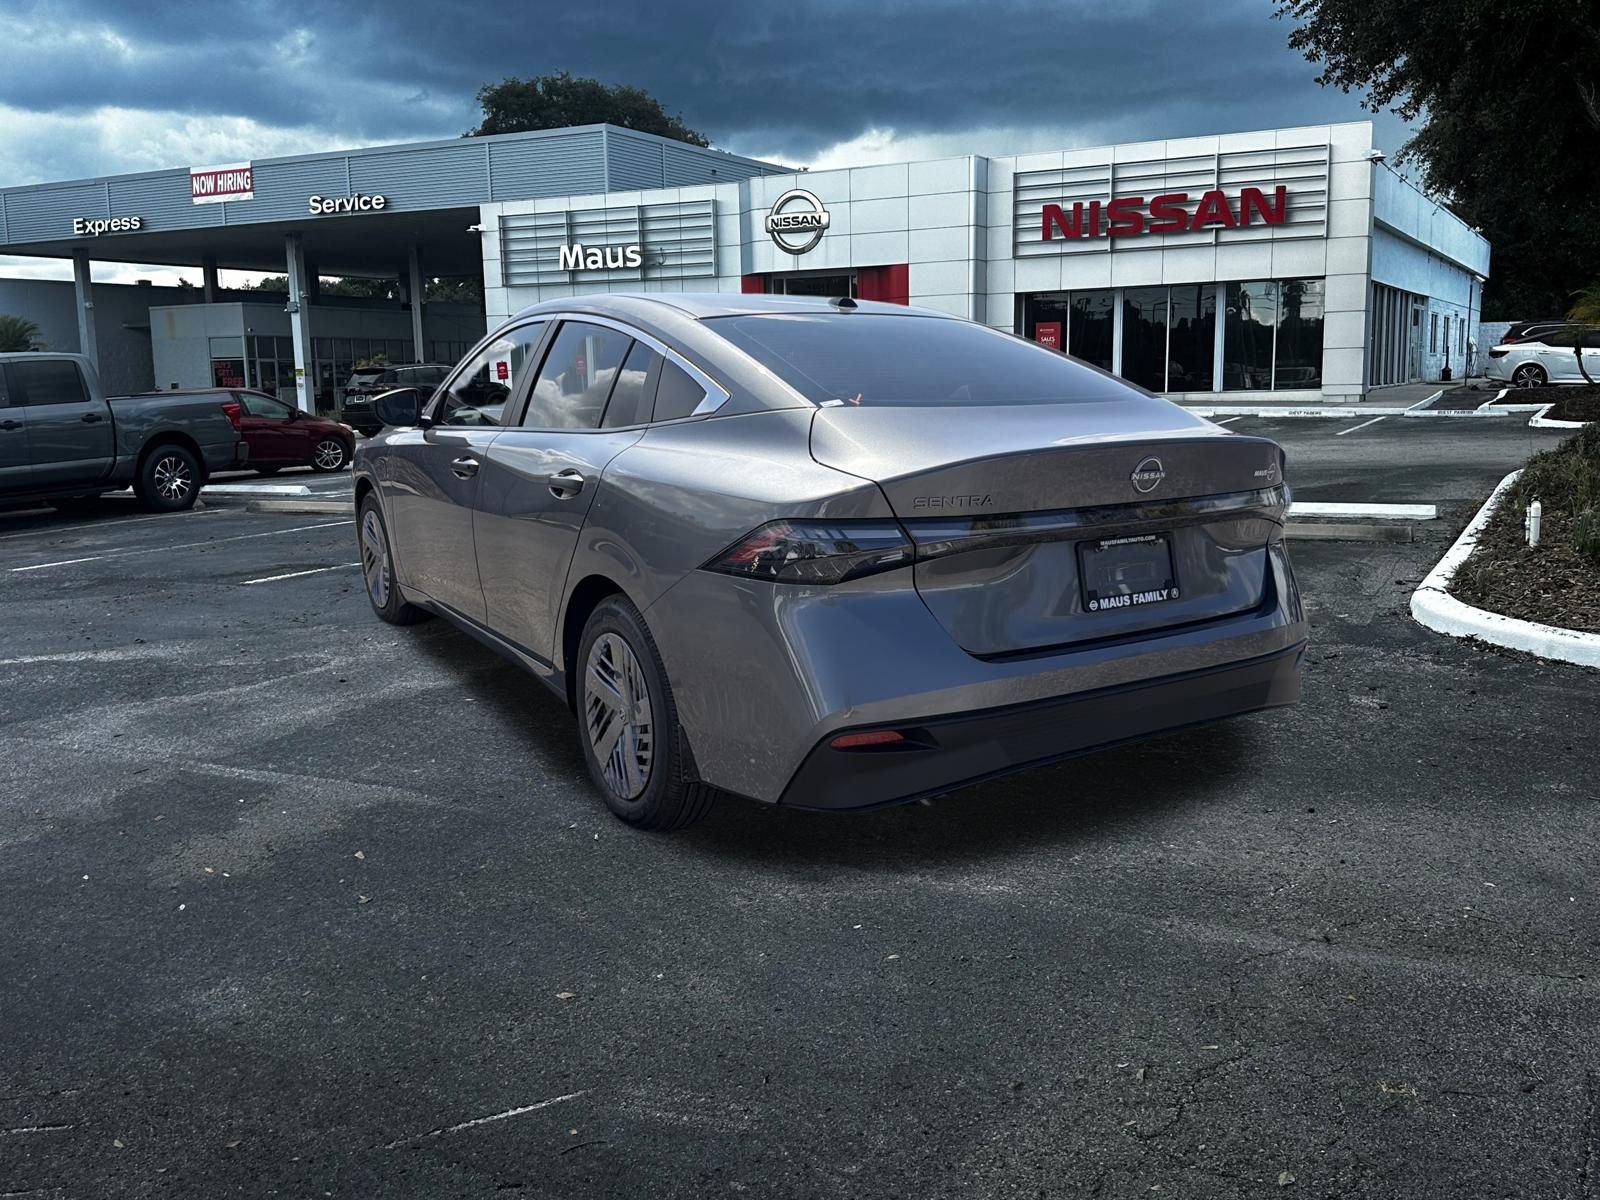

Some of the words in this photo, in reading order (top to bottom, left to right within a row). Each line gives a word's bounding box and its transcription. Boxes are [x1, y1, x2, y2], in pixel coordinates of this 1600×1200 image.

[192, 174, 215, 195] NOW
[217, 171, 251, 192] HIRING
[308, 193, 386, 215] Service
[1042, 185, 1286, 240] NISSAN
[73, 215, 141, 236] Express
[769, 213, 822, 229] NISSAN
[559, 243, 641, 271] Maus
[223, 377, 244, 386] FREE
[1131, 471, 1166, 480] NISSAN
[913, 494, 993, 509] SENTRA
[1100, 595, 1131, 609] MAUS
[1132, 588, 1169, 605] FAMILY
